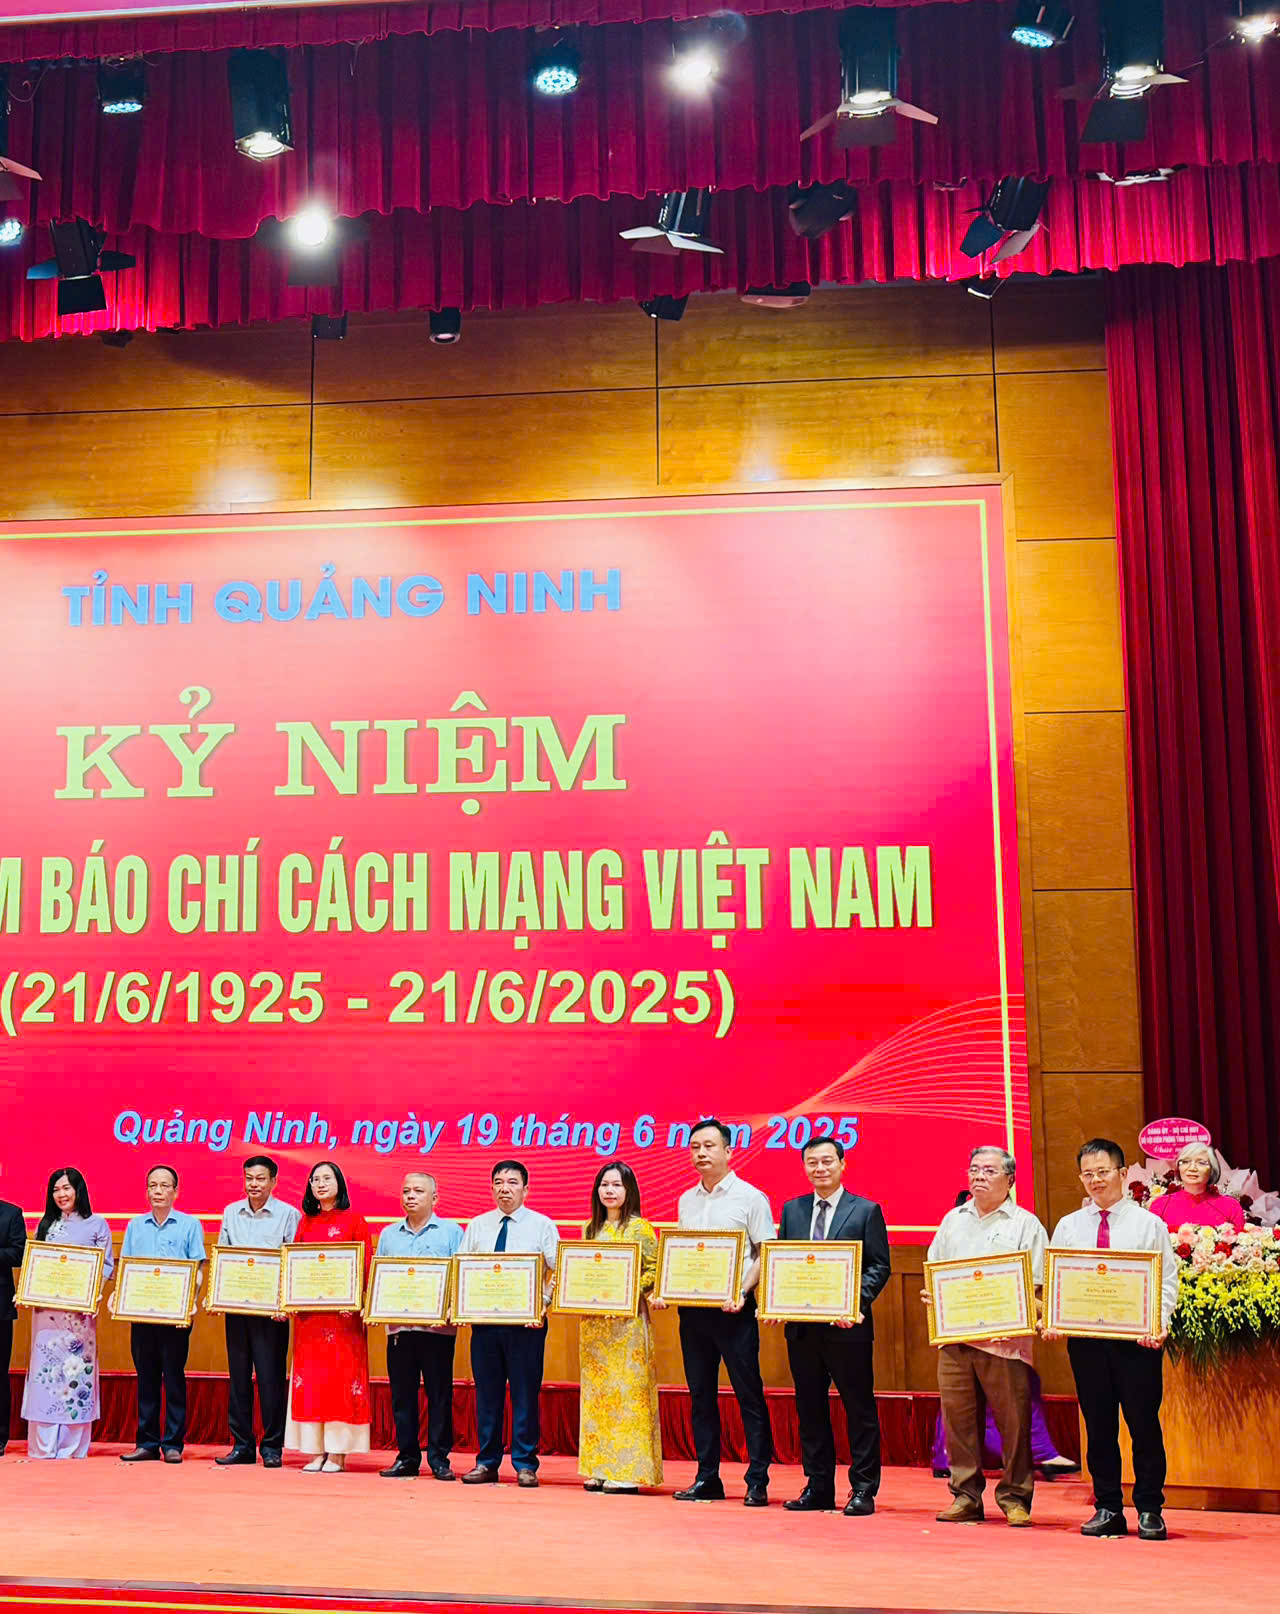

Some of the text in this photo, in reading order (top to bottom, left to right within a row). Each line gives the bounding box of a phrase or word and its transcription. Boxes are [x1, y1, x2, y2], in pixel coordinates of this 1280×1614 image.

[63, 564, 620, 626] TỈNH QUẢNG NINH
[56, 688, 626, 815] KỶ NIỆM
[40, 840, 148, 934] BÁO
[169, 840, 259, 933] CHÍ
[279, 837, 427, 933] CÁCH
[450, 850, 623, 949] MẠNG
[644, 832, 769, 948] VIỆT
[791, 847, 932, 930] NAM
[1, 970, 734, 1037] (21/6/1925 - 21/6/2025)
[114, 1112, 232, 1150] Quảng
[244, 1112, 336, 1148] Ninh,
[352, 1114, 444, 1154] ngày
[459, 1114, 498, 1146] 19
[512, 1115, 620, 1154] tháng
[634, 1116, 654, 1148] 6
[668, 1115, 752, 1148] nm
